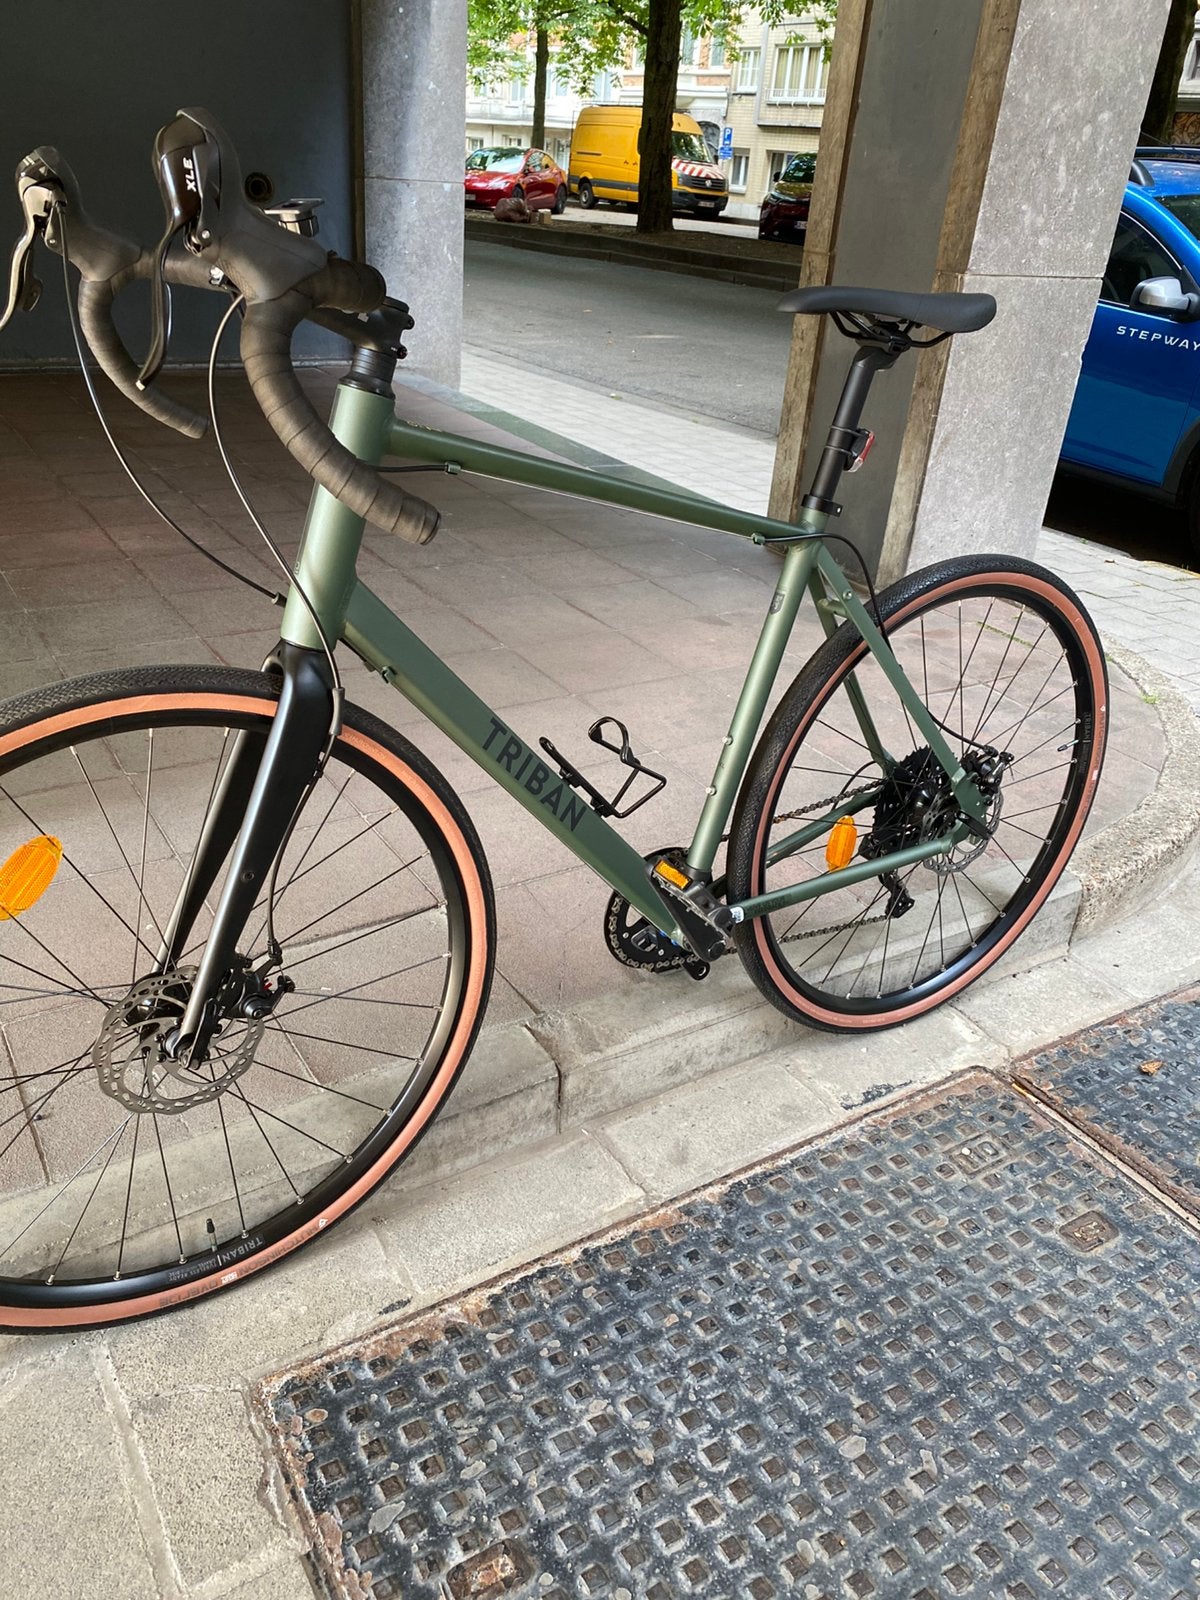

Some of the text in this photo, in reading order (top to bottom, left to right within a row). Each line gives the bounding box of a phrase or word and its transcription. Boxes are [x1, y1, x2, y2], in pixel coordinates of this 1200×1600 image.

[183, 157, 197, 192] XLE
[1116, 325, 1200, 351] STEPWAY
[482, 717, 588, 832] TRIBAN
[221, 1237, 264, 1263] TRIBAN
[237, 1224, 320, 1276] HUTCHINSON
